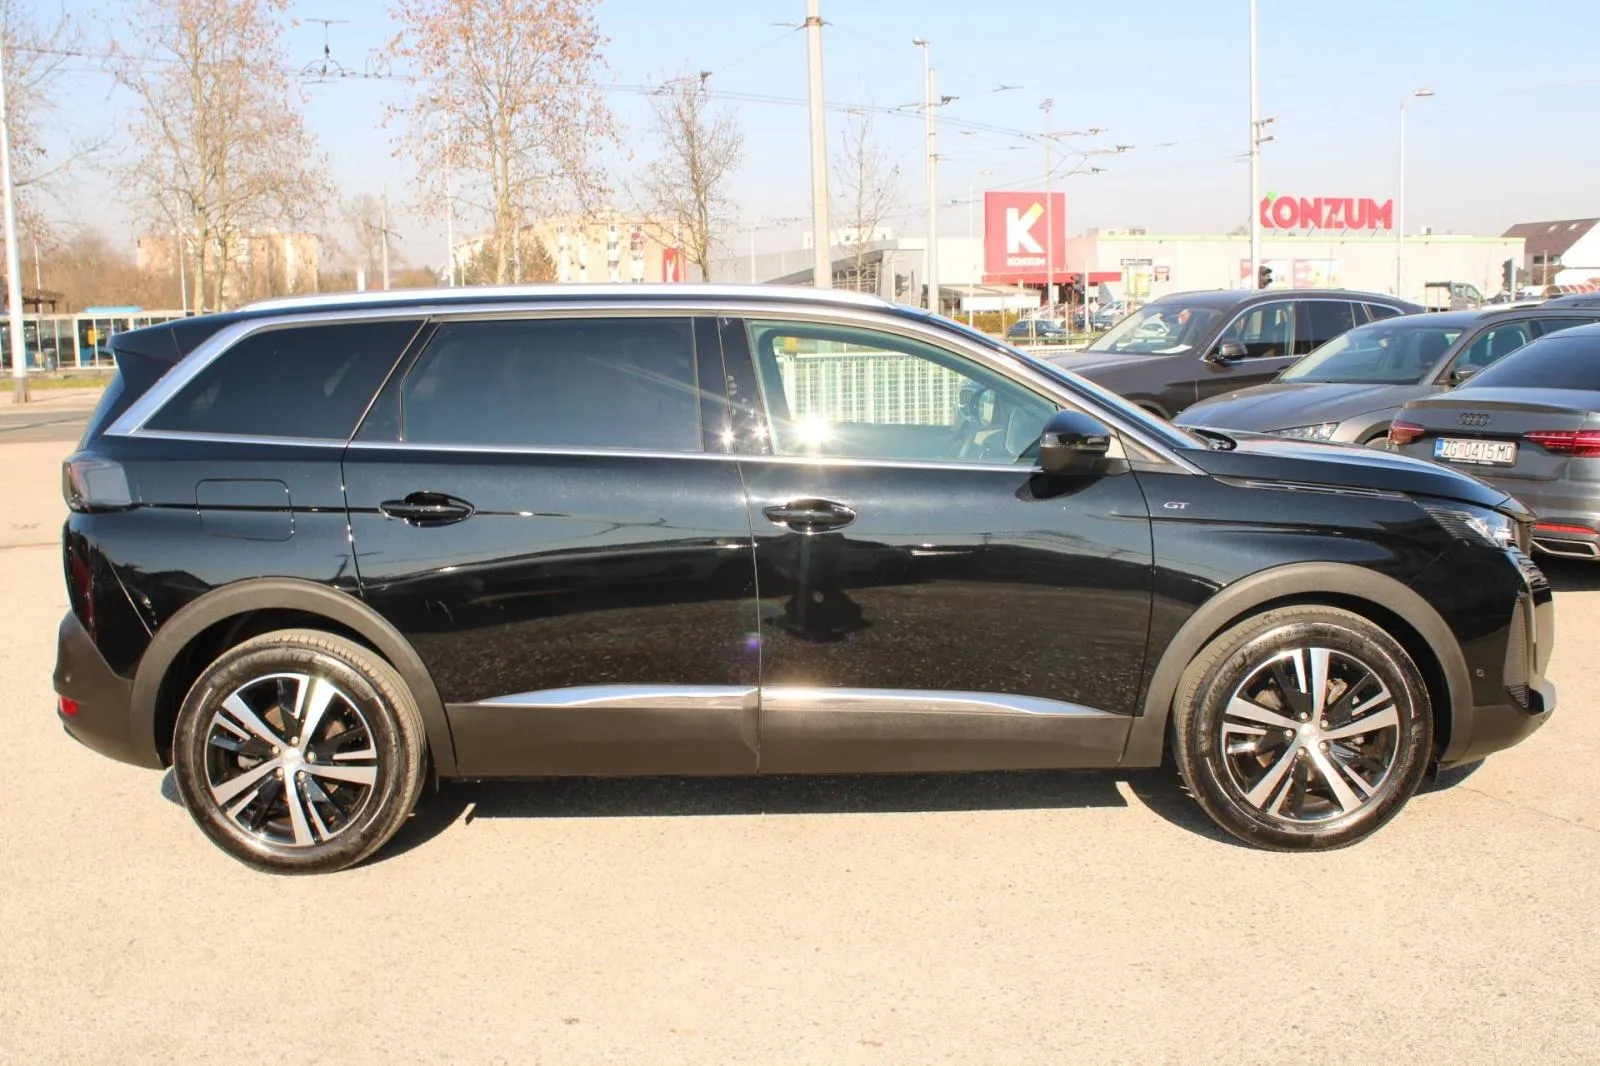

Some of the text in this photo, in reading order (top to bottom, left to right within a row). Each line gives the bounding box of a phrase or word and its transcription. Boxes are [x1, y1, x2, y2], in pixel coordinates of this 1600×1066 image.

[1006, 202, 1045, 254] K
[1260, 192, 1393, 229] KONZUM
[1163, 501, 1190, 509] GT
